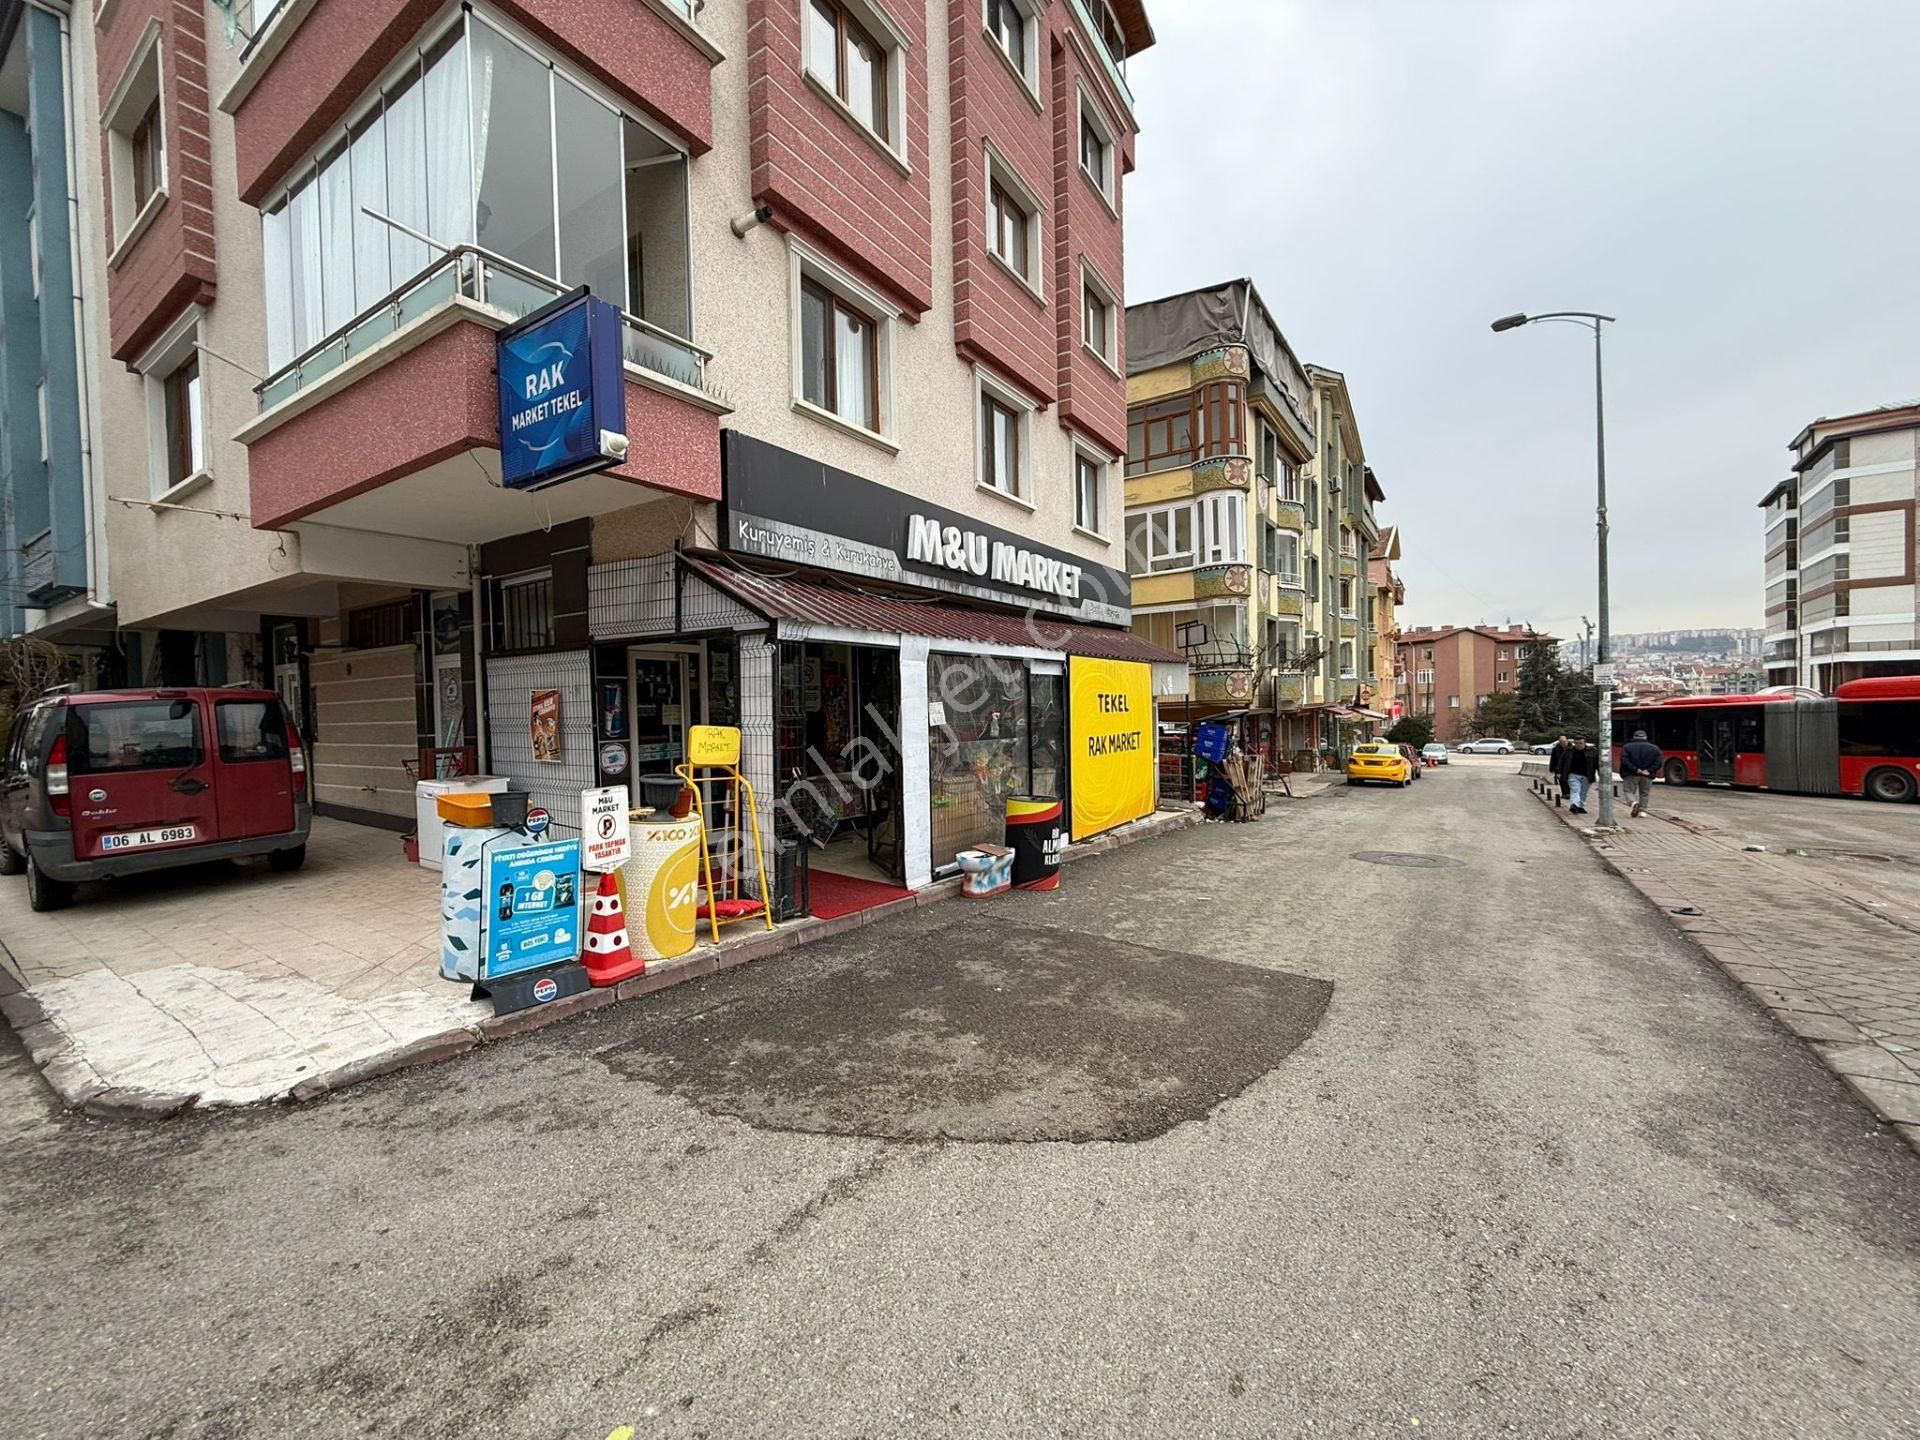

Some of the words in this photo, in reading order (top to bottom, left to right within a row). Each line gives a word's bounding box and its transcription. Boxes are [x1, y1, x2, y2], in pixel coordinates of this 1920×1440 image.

[525, 360, 565, 399] RAK
[511, 401, 550, 432] MARKET
[550, 390, 583, 416] TEKEL
[738, 519, 816, 557] Kuruyemiş
[821, 540, 831, 557] &
[836, 542, 896, 571] Kurukahve
[907, 514, 988, 576] M&U
[991, 541, 1082, 599] MARKET
[1097, 693, 1130, 713] TEKEL
[1088, 735, 1108, 757] RAK
[1109, 731, 1141, 754] MARKET
[592, 803, 619, 815] MARKET
[112, 835, 130, 847] 06
[139, 832, 155, 844] AL
[161, 827, 193, 841] 6983
[588, 843, 604, 853] PARK
[604, 838, 626, 850] YAPMAK
[594, 847, 622, 860] YASAKTIR
[524, 892, 530, 902] 1
[531, 891, 545, 901] GB
[535, 985, 556, 995] PEPSI
